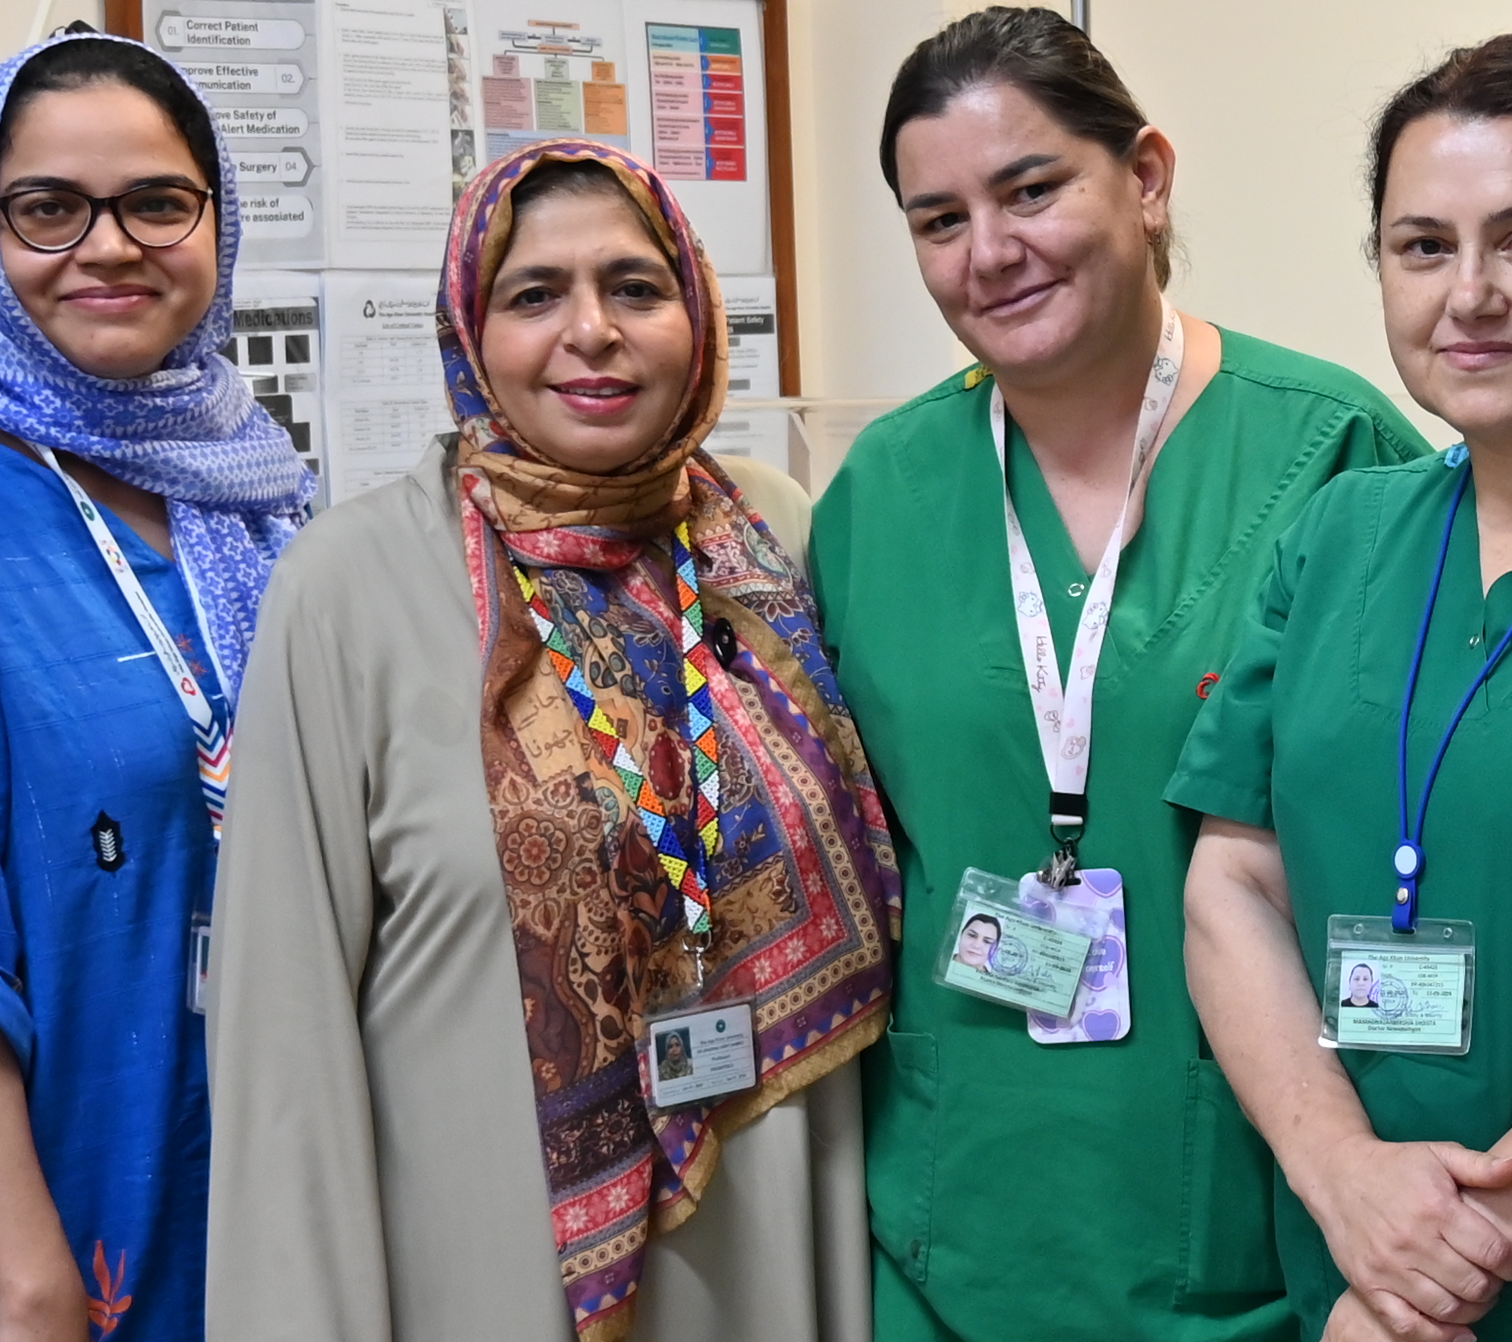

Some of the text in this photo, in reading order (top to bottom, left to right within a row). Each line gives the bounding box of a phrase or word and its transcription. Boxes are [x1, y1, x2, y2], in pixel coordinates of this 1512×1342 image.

[186, 20, 259, 32] Correct Patient
[187, 35, 251, 46] Identification
[216, 65, 259, 77] Effective
[233, 110, 264, 121] Safety
[267, 110, 277, 120] of
[246, 124, 301, 135] Medication
[239, 162, 277, 173] Surgery
[250, 198, 268, 208] risk
[270, 198, 280, 208] of
